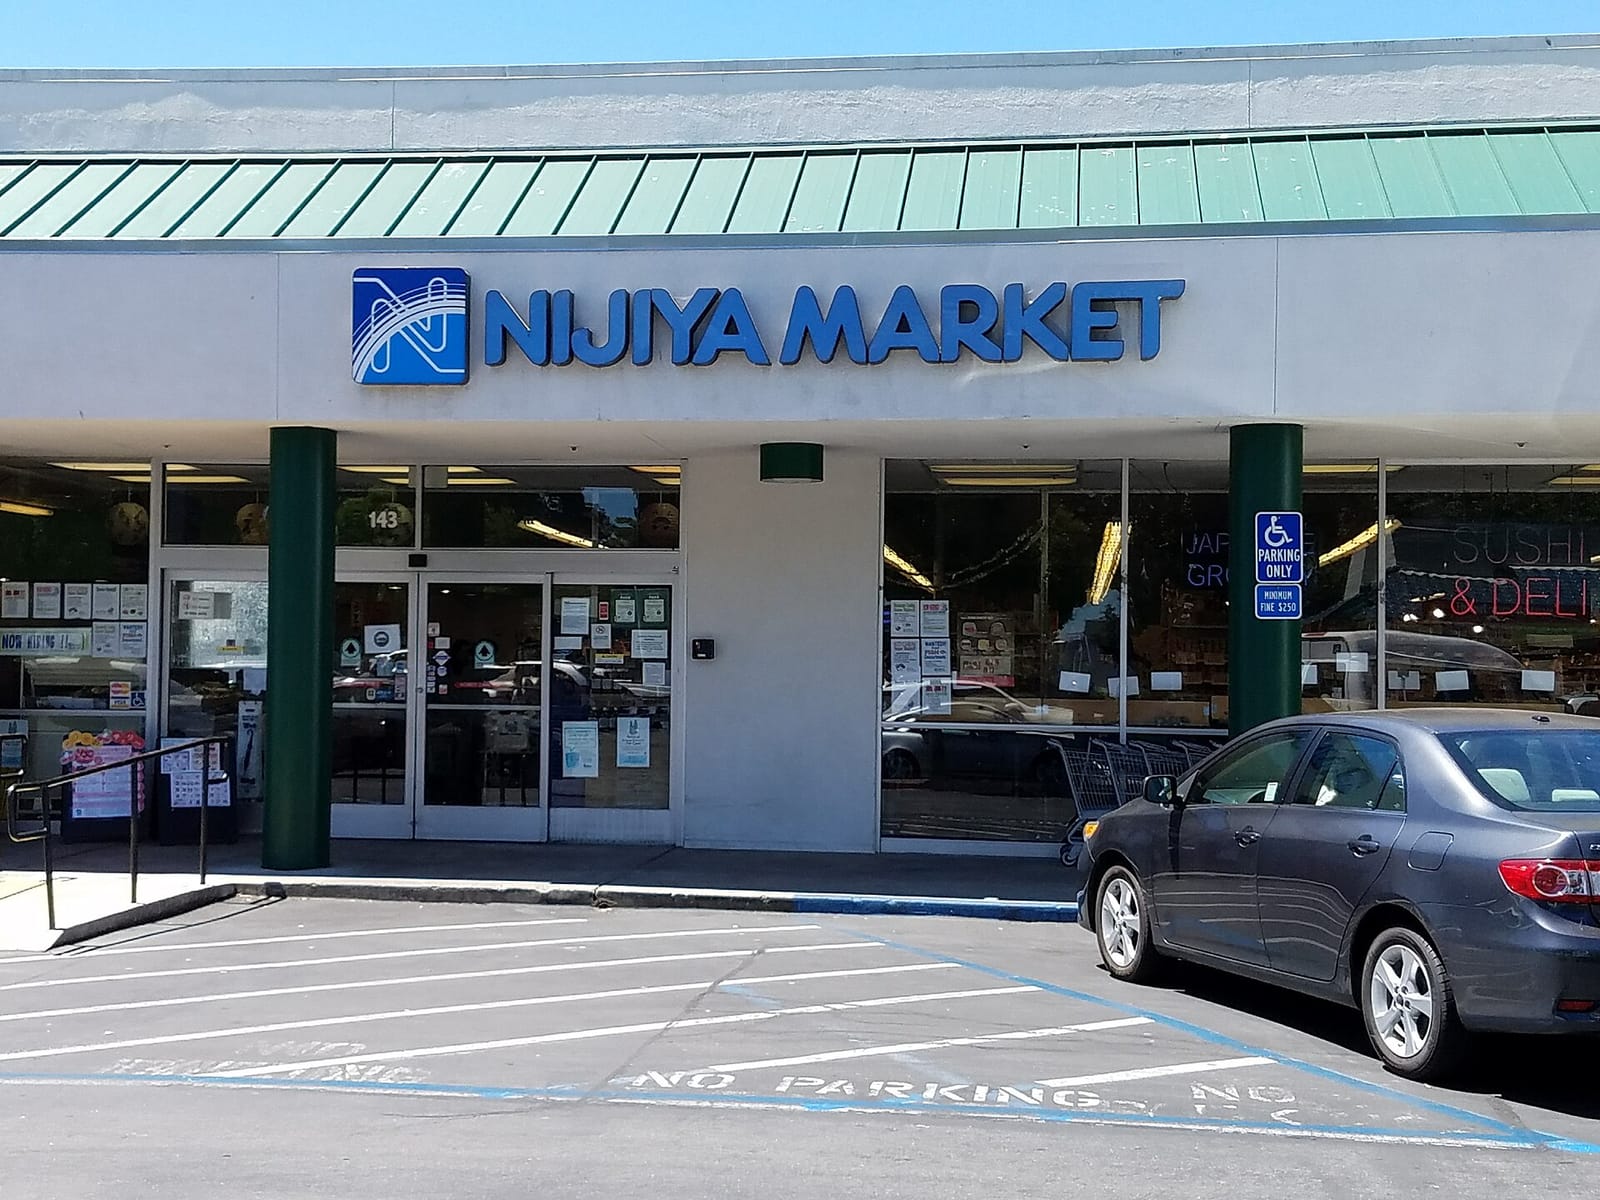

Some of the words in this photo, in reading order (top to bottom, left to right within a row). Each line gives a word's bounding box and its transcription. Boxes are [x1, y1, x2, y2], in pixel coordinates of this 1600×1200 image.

[485, 287, 772, 367] NIJIYA
[779, 279, 1186, 364] MARKET
[369, 511, 398, 528] 143
[1453, 526, 1584, 564] SUSHI
[1258, 548, 1300, 562] PARKING
[1266, 564, 1293, 578] ONLY
[1264, 591, 1293, 600] MINIMUM
[1451, 577, 1477, 616] &
[1492, 577, 1586, 616] DELI
[1260, 602, 1275, 612] FINE
[1278, 602, 1297, 612] $250
[2, 634, 22, 649] NOW
[632, 1070, 735, 1090] NO
[775, 1076, 1101, 1107] PARKING
[1190, 1081, 1296, 1103] NO
